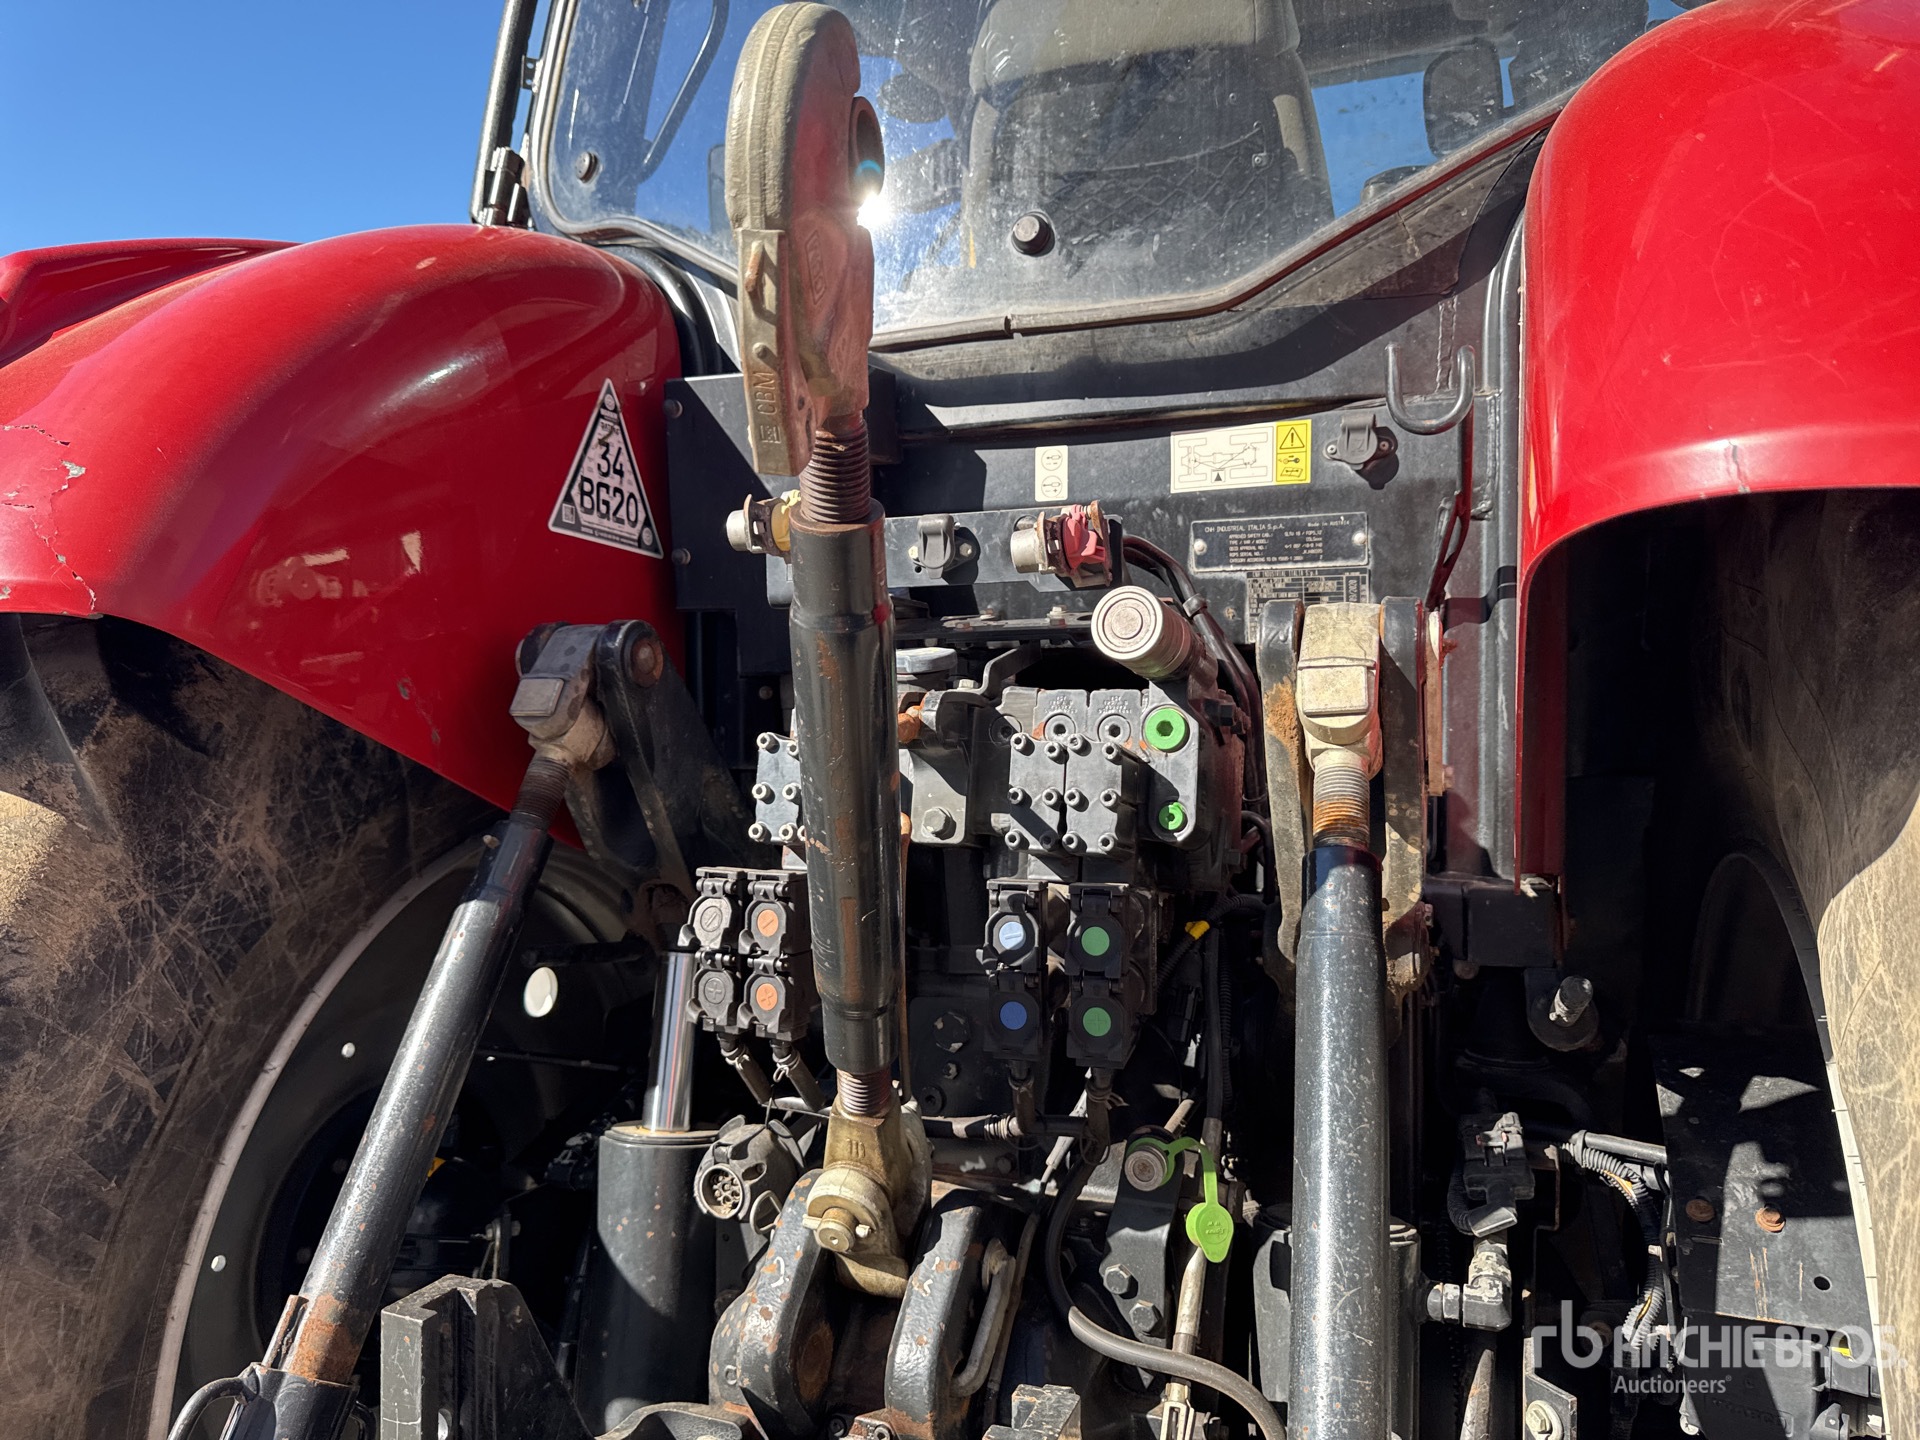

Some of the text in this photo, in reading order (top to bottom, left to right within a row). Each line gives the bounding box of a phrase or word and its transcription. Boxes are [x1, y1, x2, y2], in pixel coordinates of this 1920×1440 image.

[753, 371, 777, 415] CBM
[597, 443, 625, 485] 34
[580, 475, 639, 528] BG20
